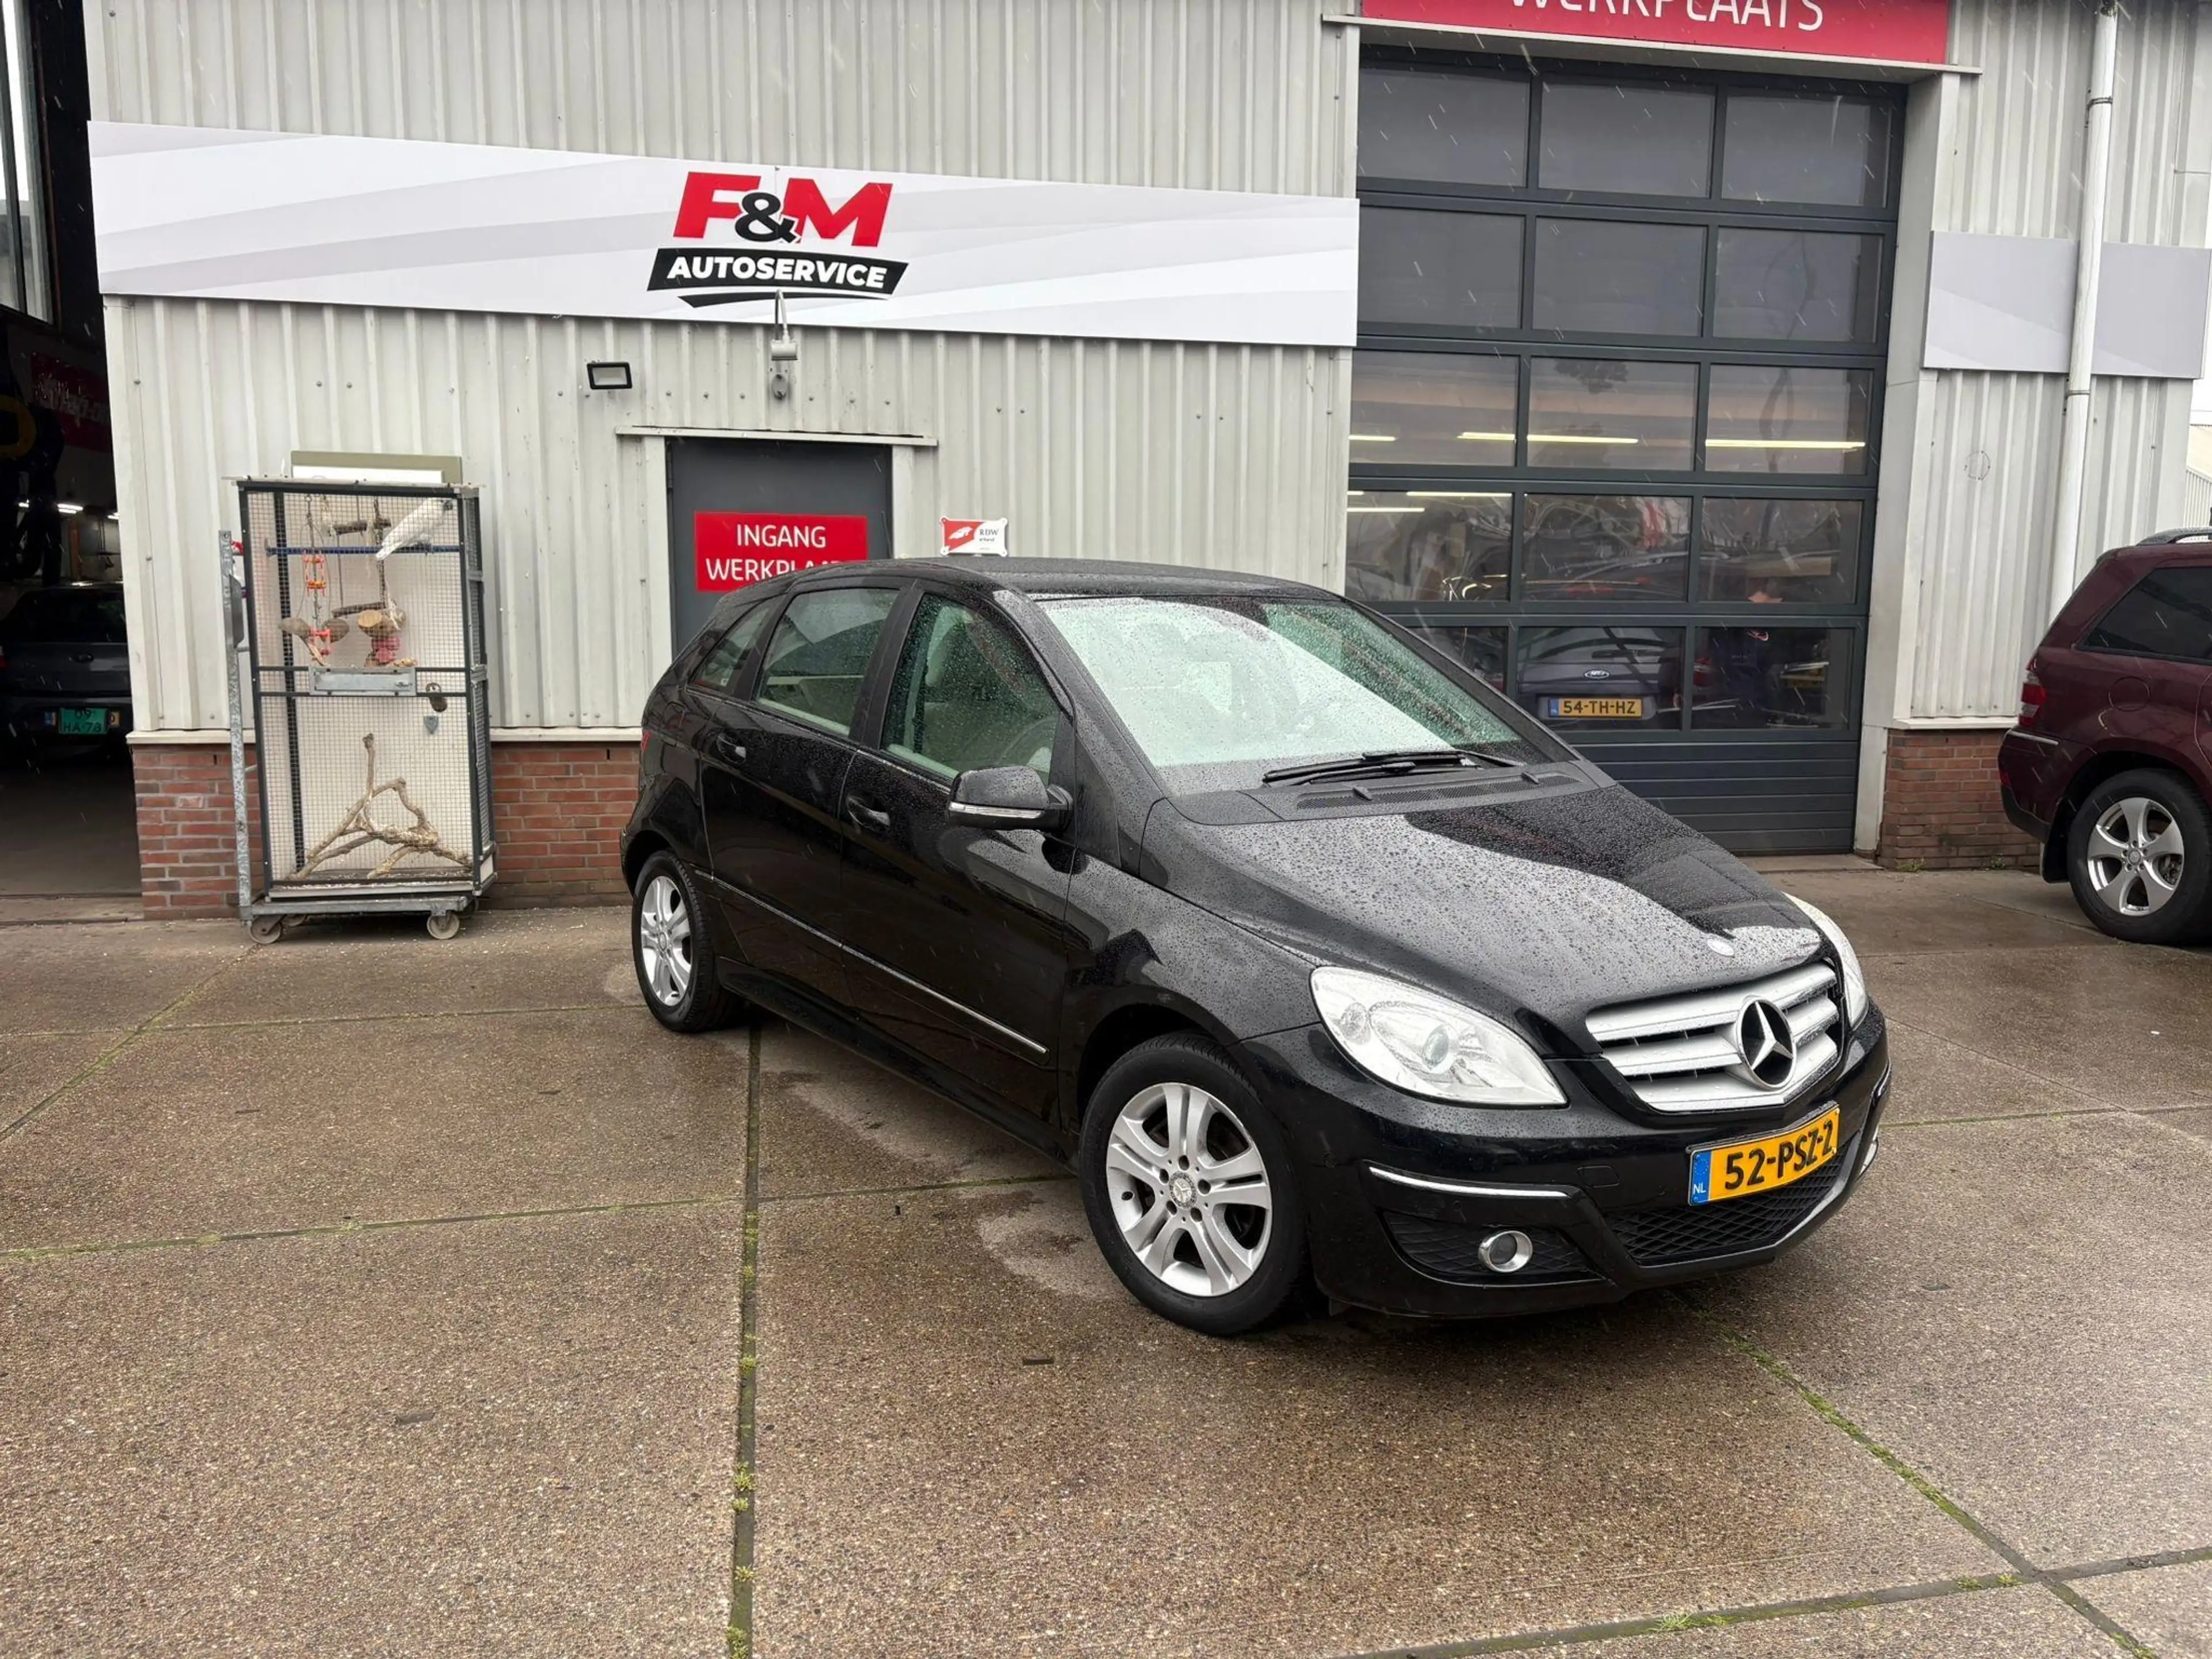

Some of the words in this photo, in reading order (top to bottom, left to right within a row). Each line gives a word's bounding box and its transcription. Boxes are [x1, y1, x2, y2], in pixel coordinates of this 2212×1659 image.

[1513, 0, 1823, 31] LAATS
[673, 172, 893, 248] F&M
[667, 256, 888, 289] AUTOSERVICE
[737, 524, 826, 548] INGANG
[706, 558, 838, 581] WERKP
[1563, 700, 1636, 714] 54-TH-HZ
[1725, 1119, 1834, 1190] 52-PSZ-2
[1693, 1182, 1706, 1194] NL
